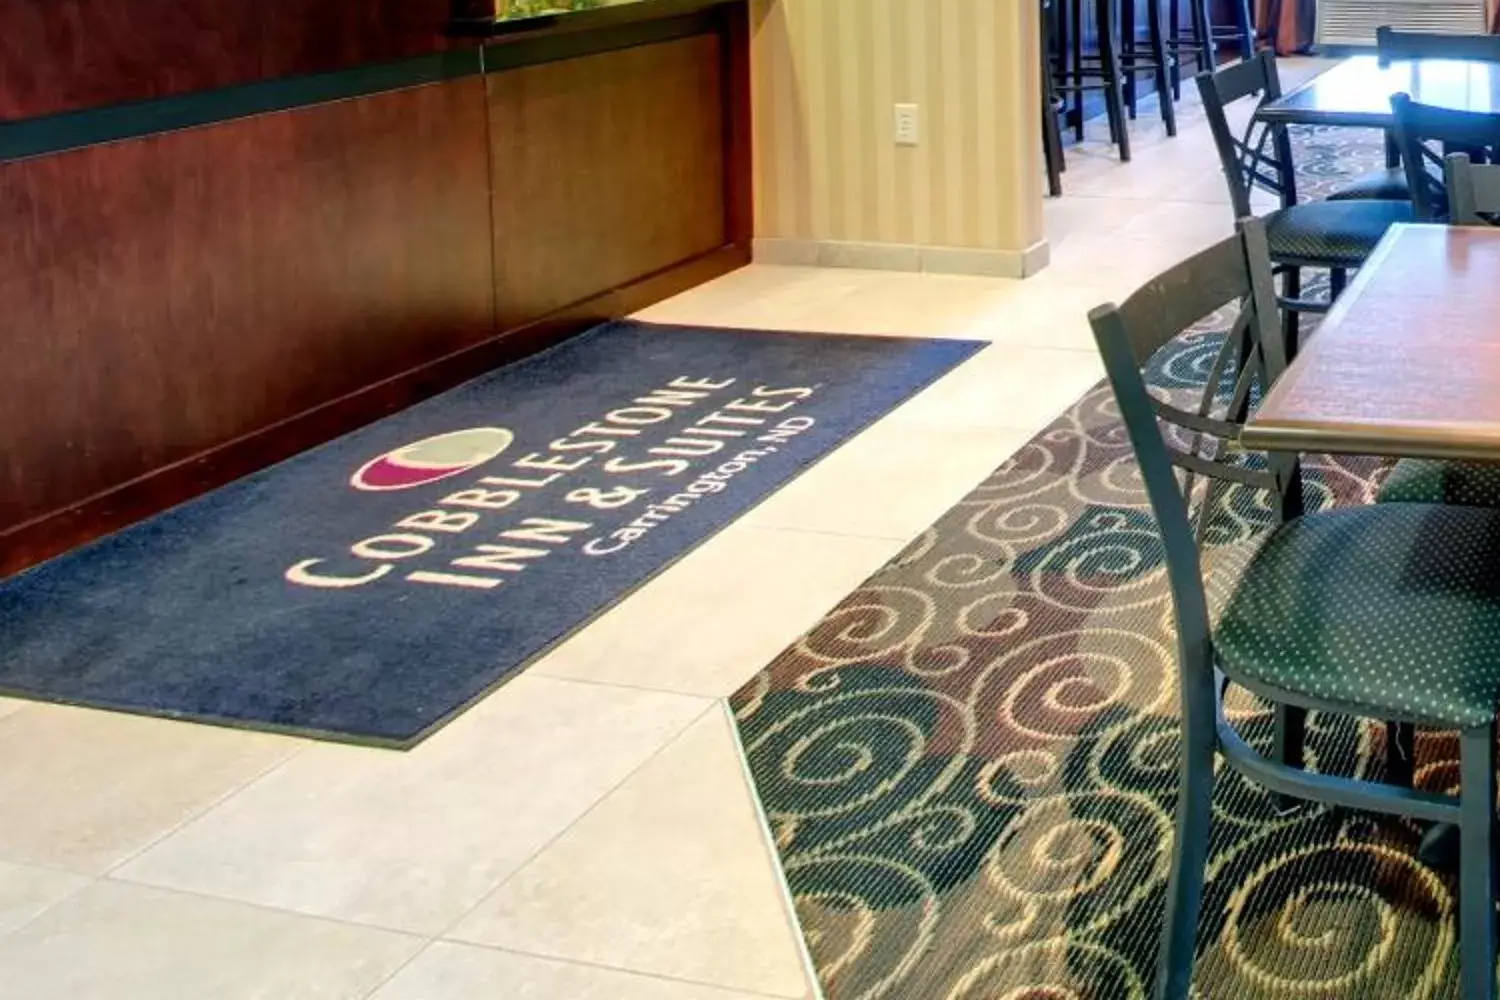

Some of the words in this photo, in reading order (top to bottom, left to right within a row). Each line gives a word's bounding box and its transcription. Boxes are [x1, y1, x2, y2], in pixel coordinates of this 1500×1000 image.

[603, 385, 814, 477] SUITES
[285, 375, 737, 588] COBBLESTONE
[564, 485, 651, 510] &
[582, 445, 778, 556] Carrington,
[757, 416, 816, 444] ND
[405, 518, 594, 589] INN
